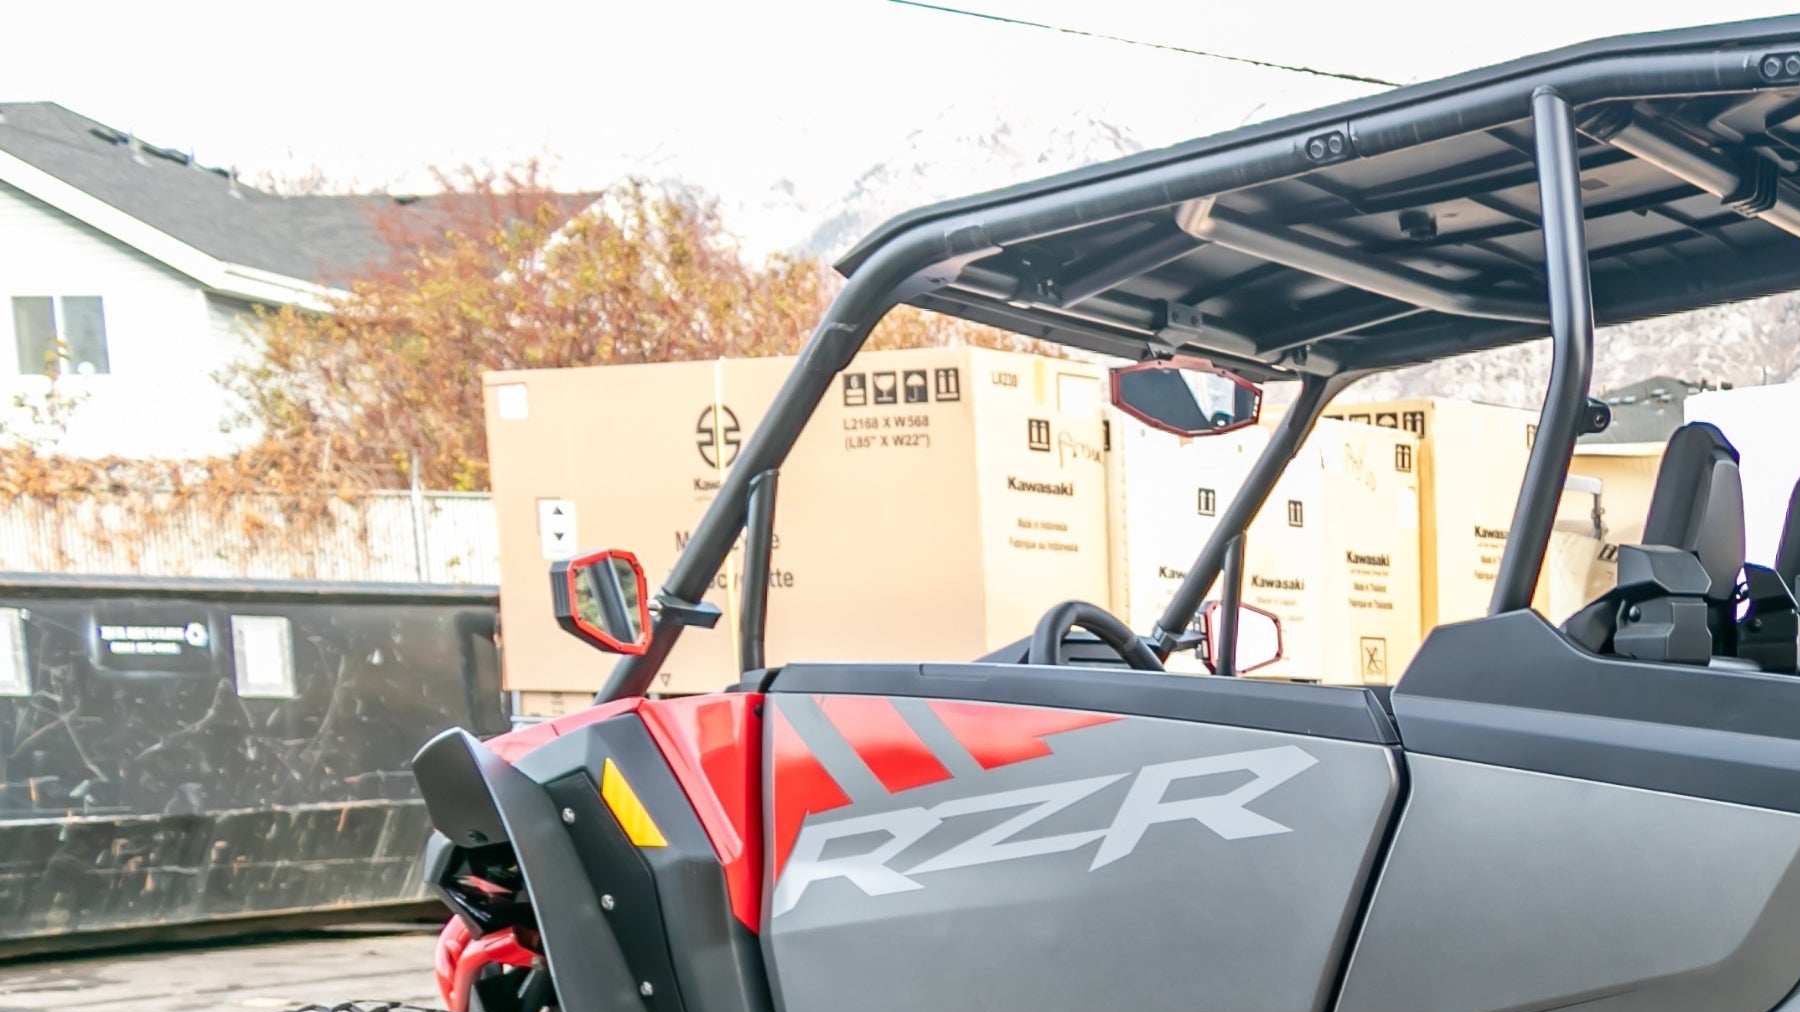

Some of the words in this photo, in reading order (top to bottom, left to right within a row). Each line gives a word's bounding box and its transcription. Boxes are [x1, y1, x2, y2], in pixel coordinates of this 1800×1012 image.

[1007, 475, 1074, 497] Kawasaki
[1346, 550, 1391, 567] Kawasaki
[1251, 574, 1306, 592] Kawasaki
[772, 744, 1320, 918] RZR
